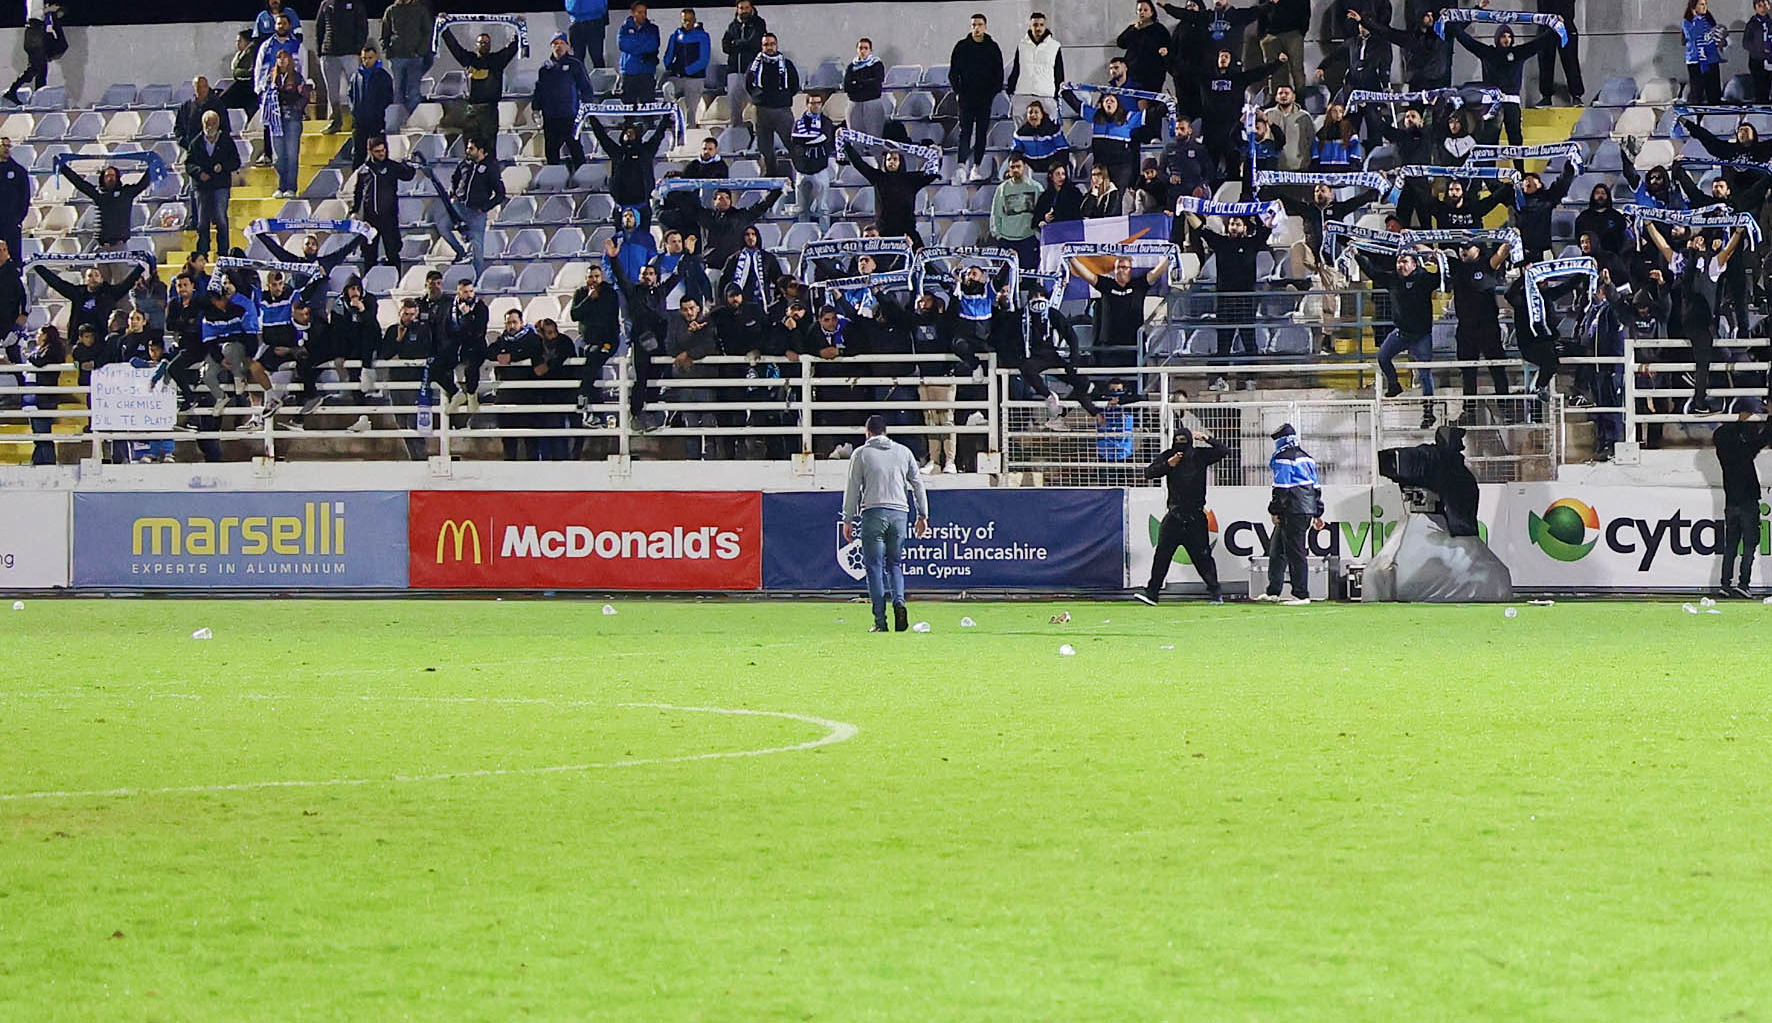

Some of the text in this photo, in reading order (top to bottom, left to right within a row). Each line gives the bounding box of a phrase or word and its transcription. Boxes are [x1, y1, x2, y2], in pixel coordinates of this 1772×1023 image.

[1502, 147, 1518, 156] 40
[1202, 200, 1263, 214] APOLLON FC
[1352, 226, 1367, 235] 40
[843, 240, 858, 251] 40
[864, 240, 879, 251] still
[1102, 243, 1117, 253] 40
[1031, 301, 1046, 311] 40
[96, 398, 162, 410] TA CHEMISE
[120, 414, 137, 426] TE
[132, 501, 345, 555] marselli
[905, 521, 995, 545] iversity of
[501, 525, 741, 559] McDonald's
[900, 542, 1048, 561] entral Lancashire
[132, 563, 346, 574] EXPERTS IN ALUMINIUM
[927, 563, 972, 579] Cyprus
